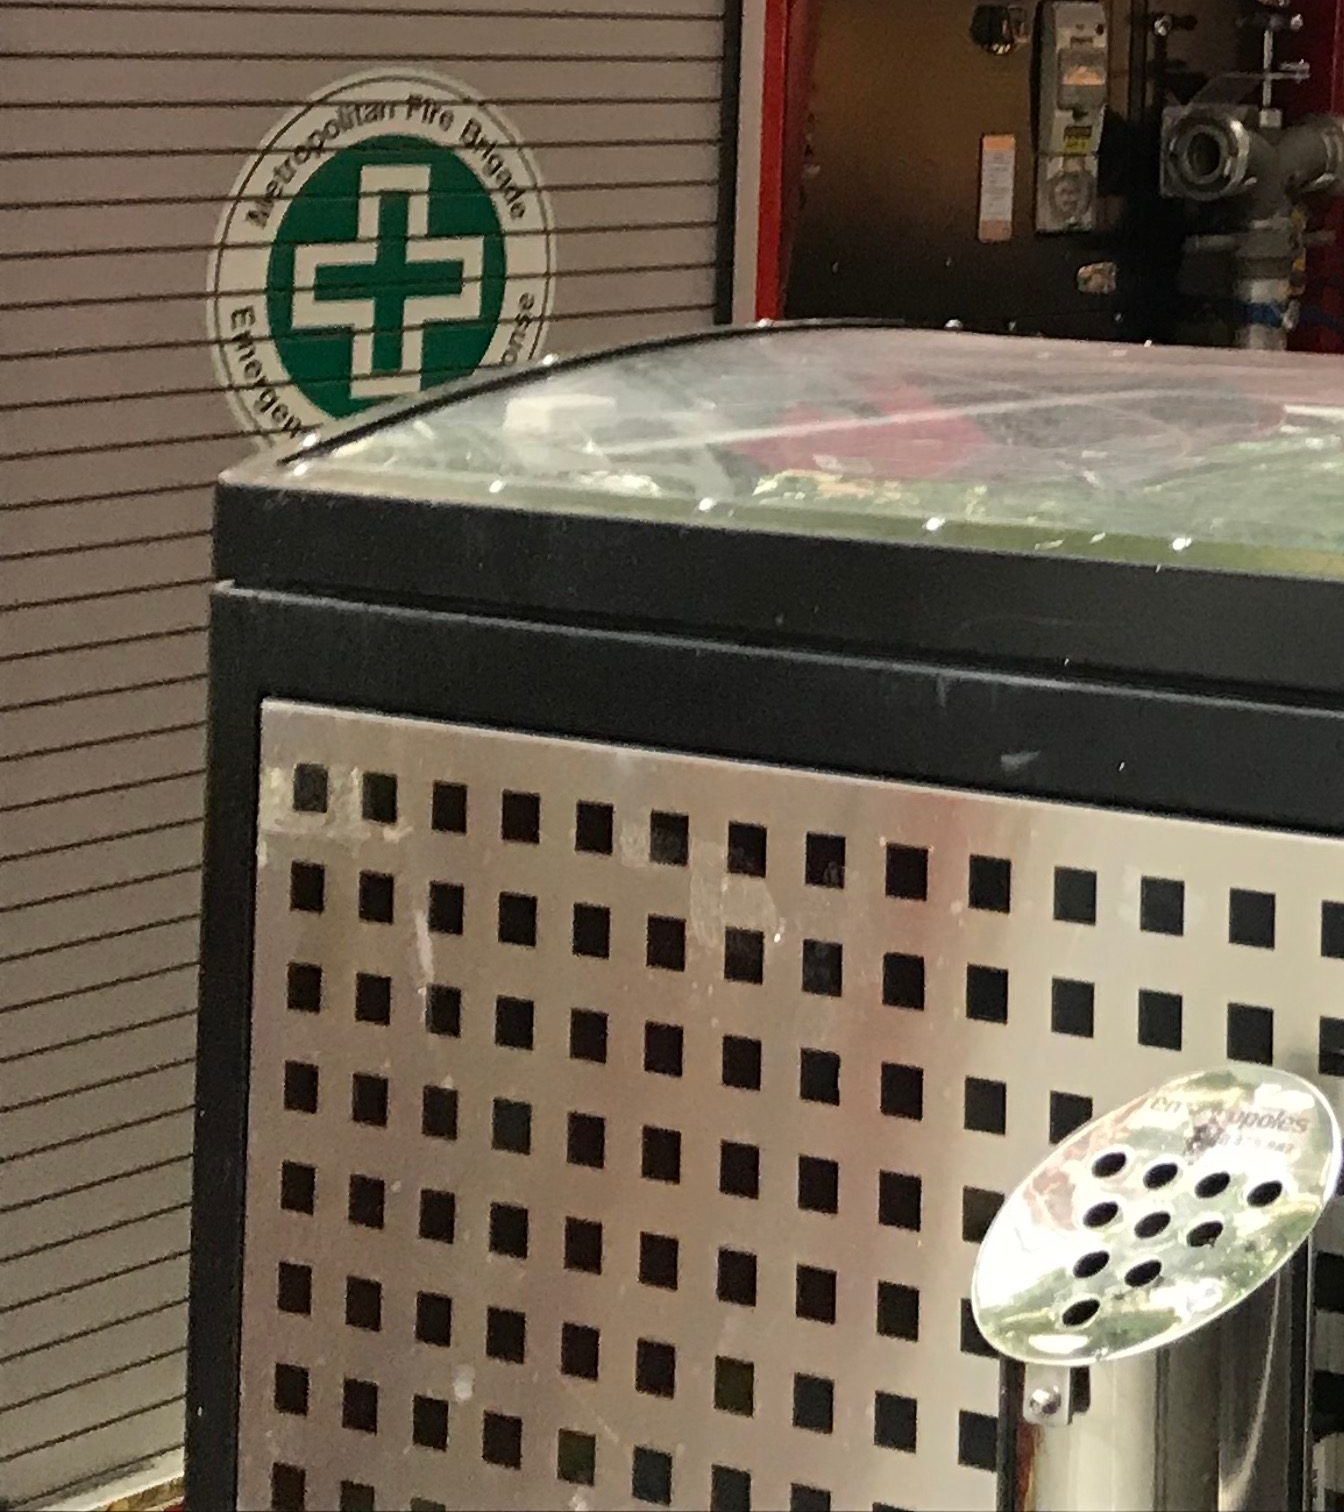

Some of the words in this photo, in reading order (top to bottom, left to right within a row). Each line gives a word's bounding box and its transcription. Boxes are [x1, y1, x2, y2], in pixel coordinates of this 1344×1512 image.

[245, 99, 397, 229] Metropolitan
[404, 92, 456, 133] Fire
[459, 116, 527, 221] Brigade
